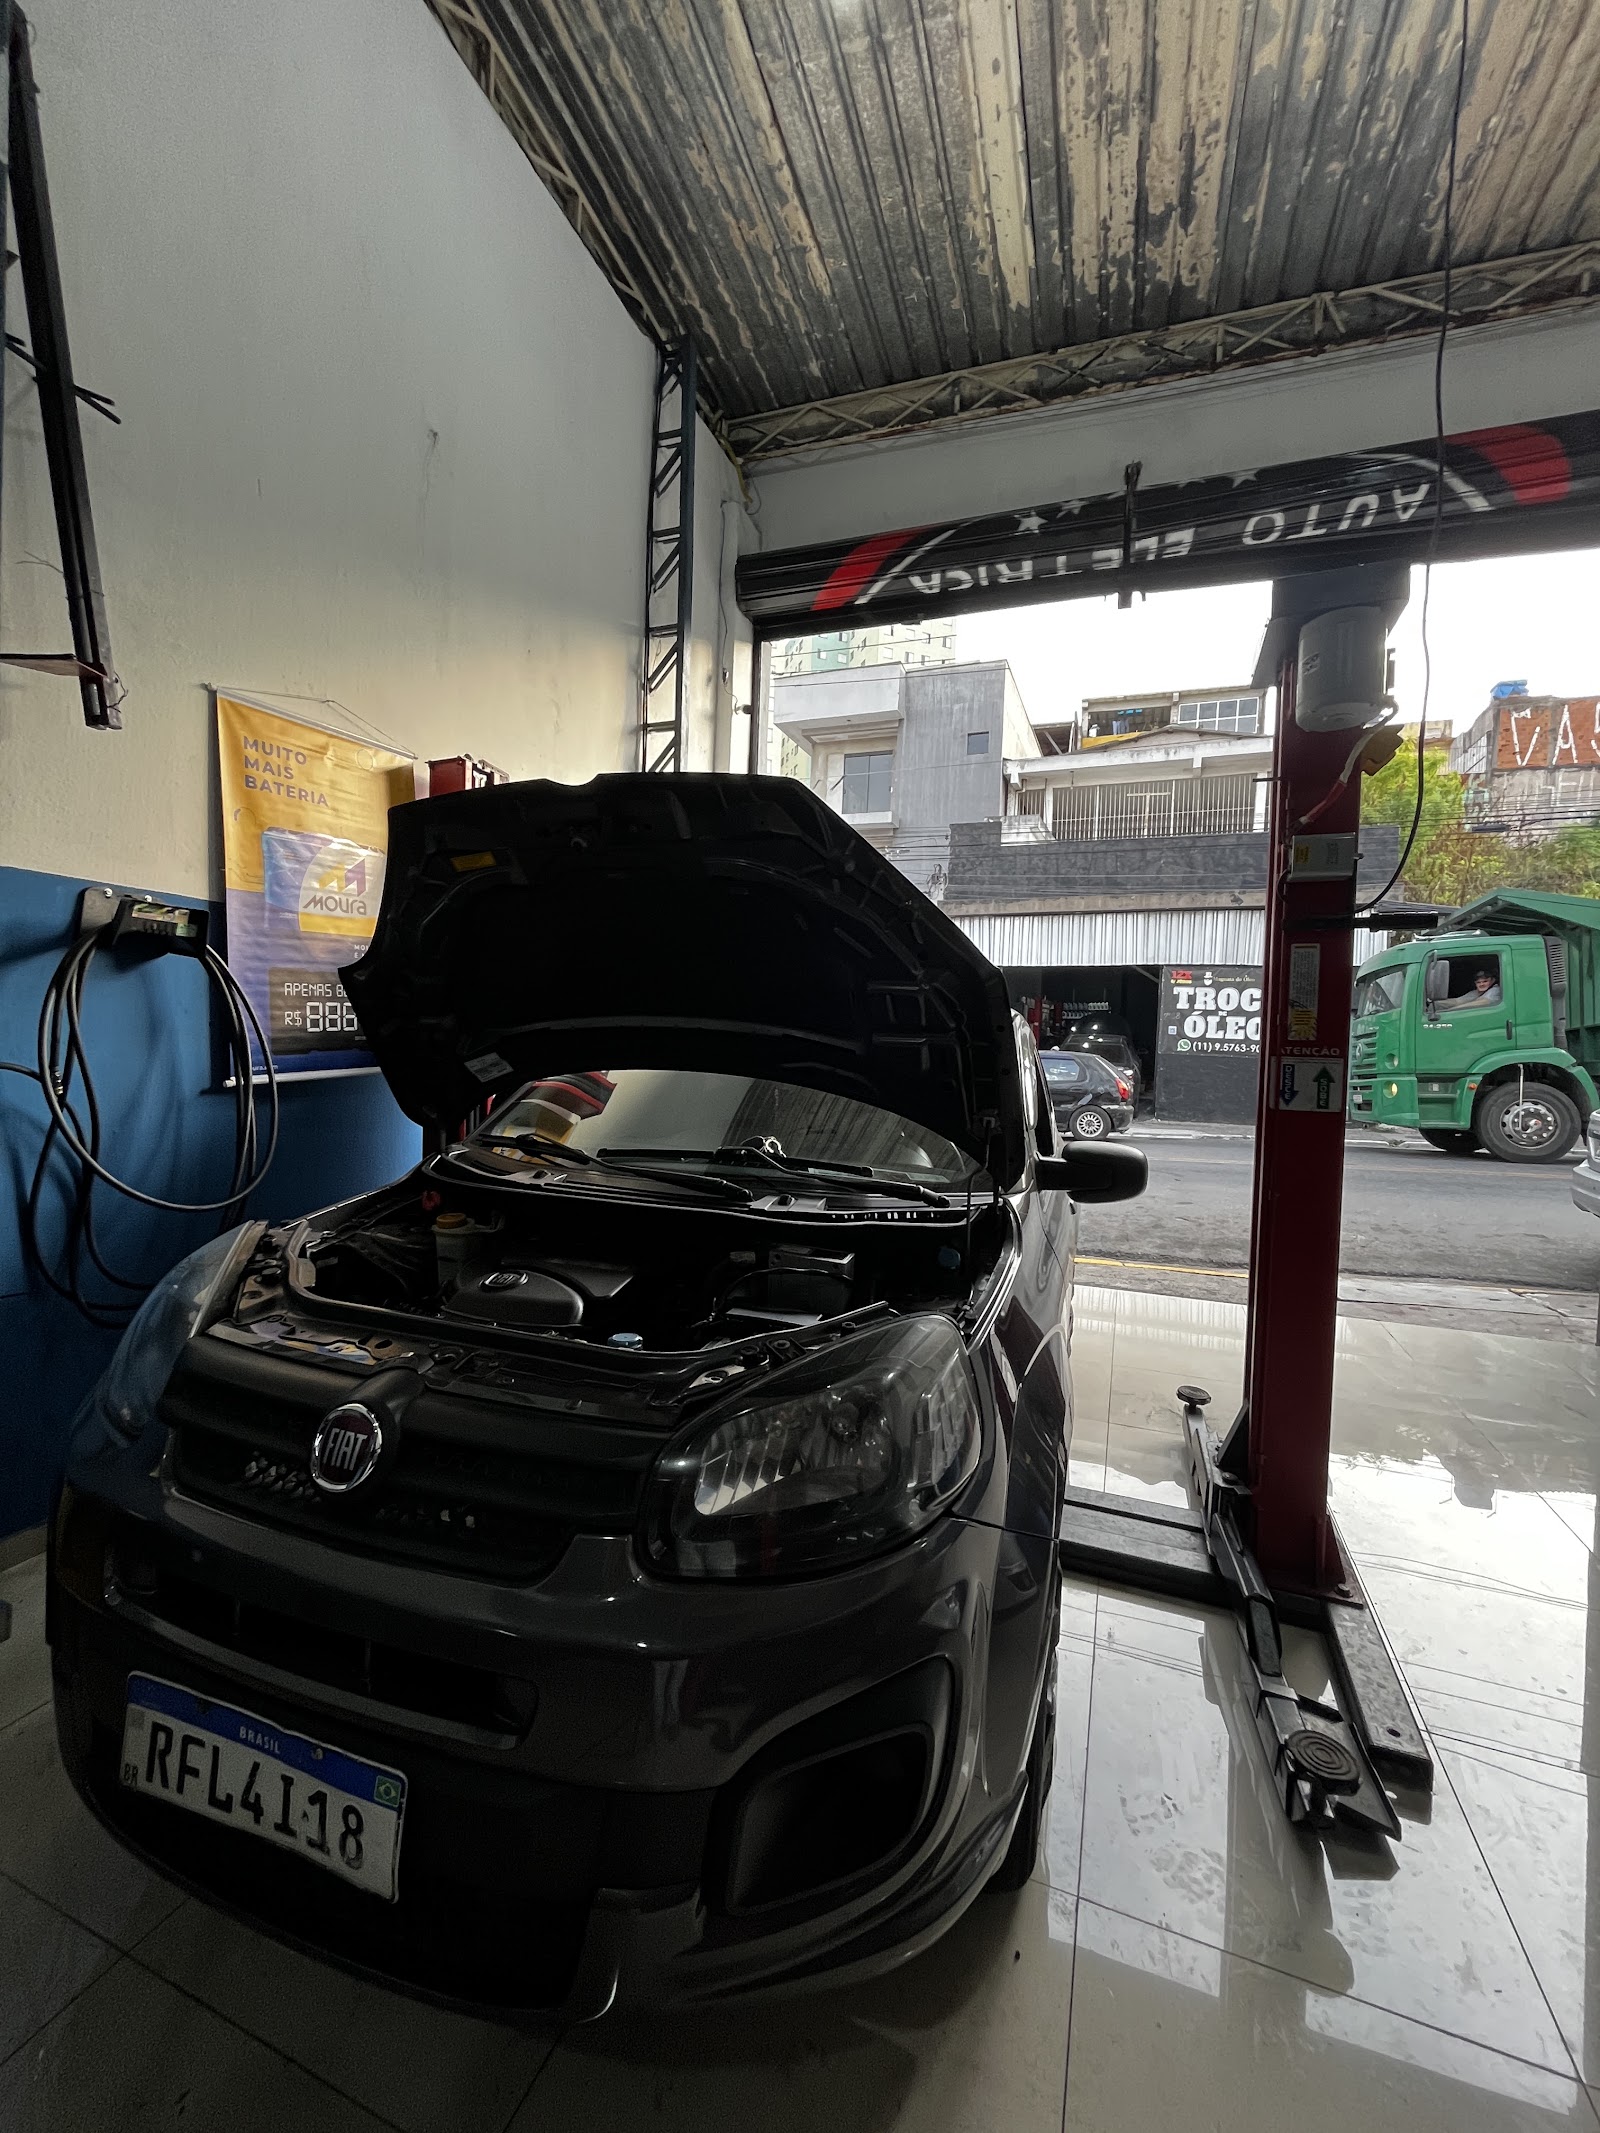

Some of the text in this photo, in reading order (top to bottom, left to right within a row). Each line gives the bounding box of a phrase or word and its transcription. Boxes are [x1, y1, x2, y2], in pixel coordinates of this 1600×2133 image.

[1242, 483, 1431, 546] AUTO
[243, 735, 308, 766] MUITO
[244, 755, 294, 781] MAIS
[245, 774, 329, 808] BATERIA
[284, 982, 332, 997] APENAS
[284, 1010, 303, 1027] R$
[1183, 1010, 1261, 1041] ÓLEO
[1192, 1041, 1213, 1053] (11)
[1284, 1065, 1293, 1100] DESCE
[1319, 1078, 1328, 1107] SOBE
[322, 1427, 369, 1471] FIAT
[238, 1725, 281, 1754] BRASIL
